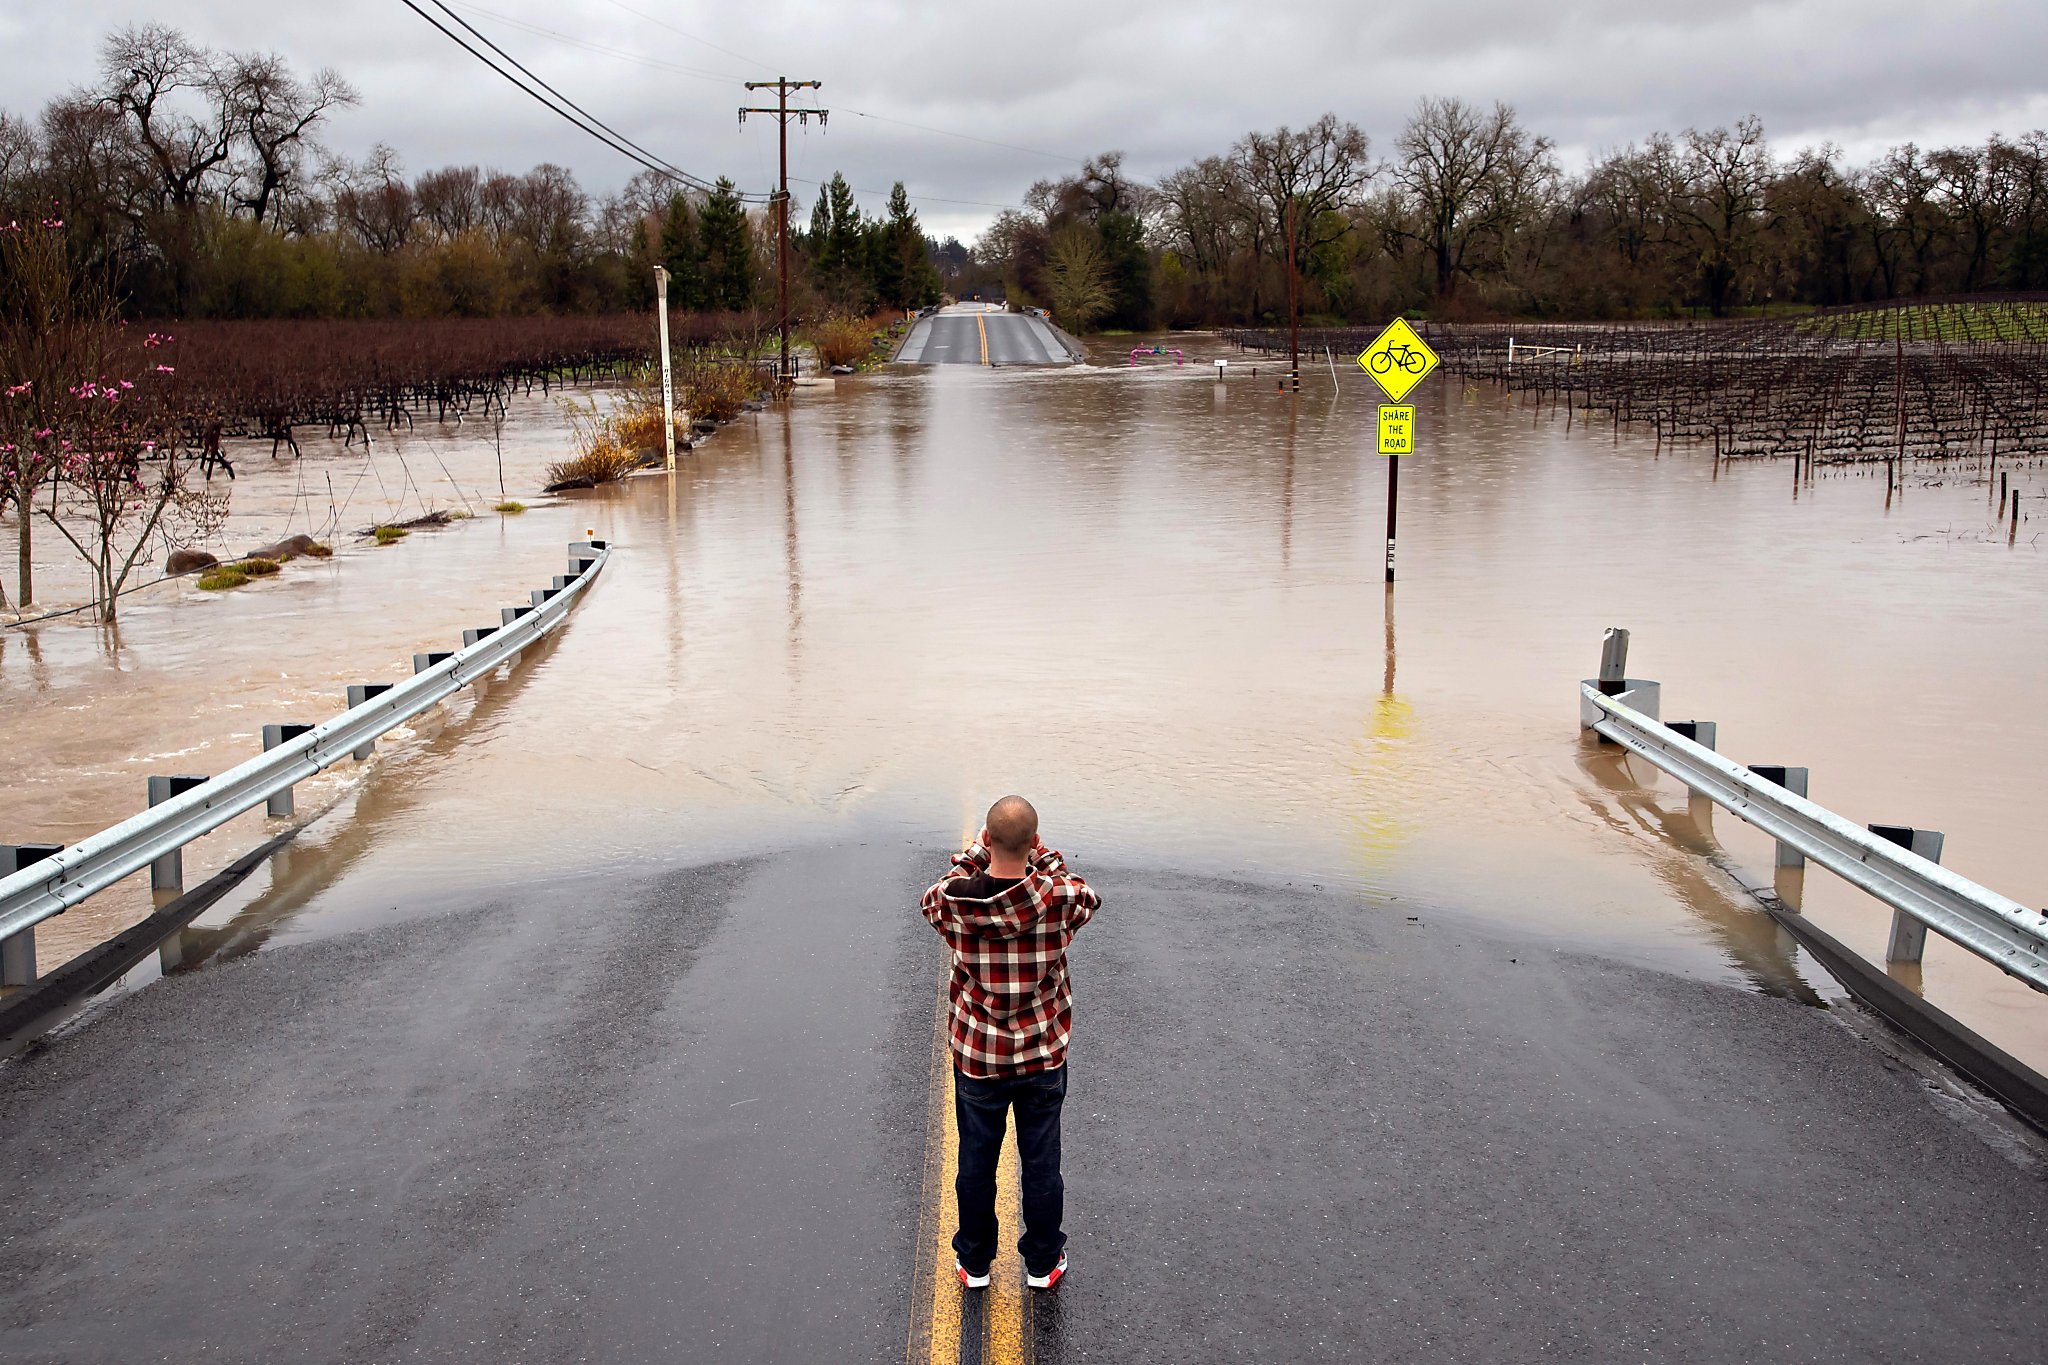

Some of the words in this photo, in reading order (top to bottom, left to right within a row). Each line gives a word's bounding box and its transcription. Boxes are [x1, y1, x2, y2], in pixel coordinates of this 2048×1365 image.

[1383, 411, 1410, 421] SHARE
[1388, 425, 1403, 434] THE
[1384, 438, 1407, 448] ROAD
